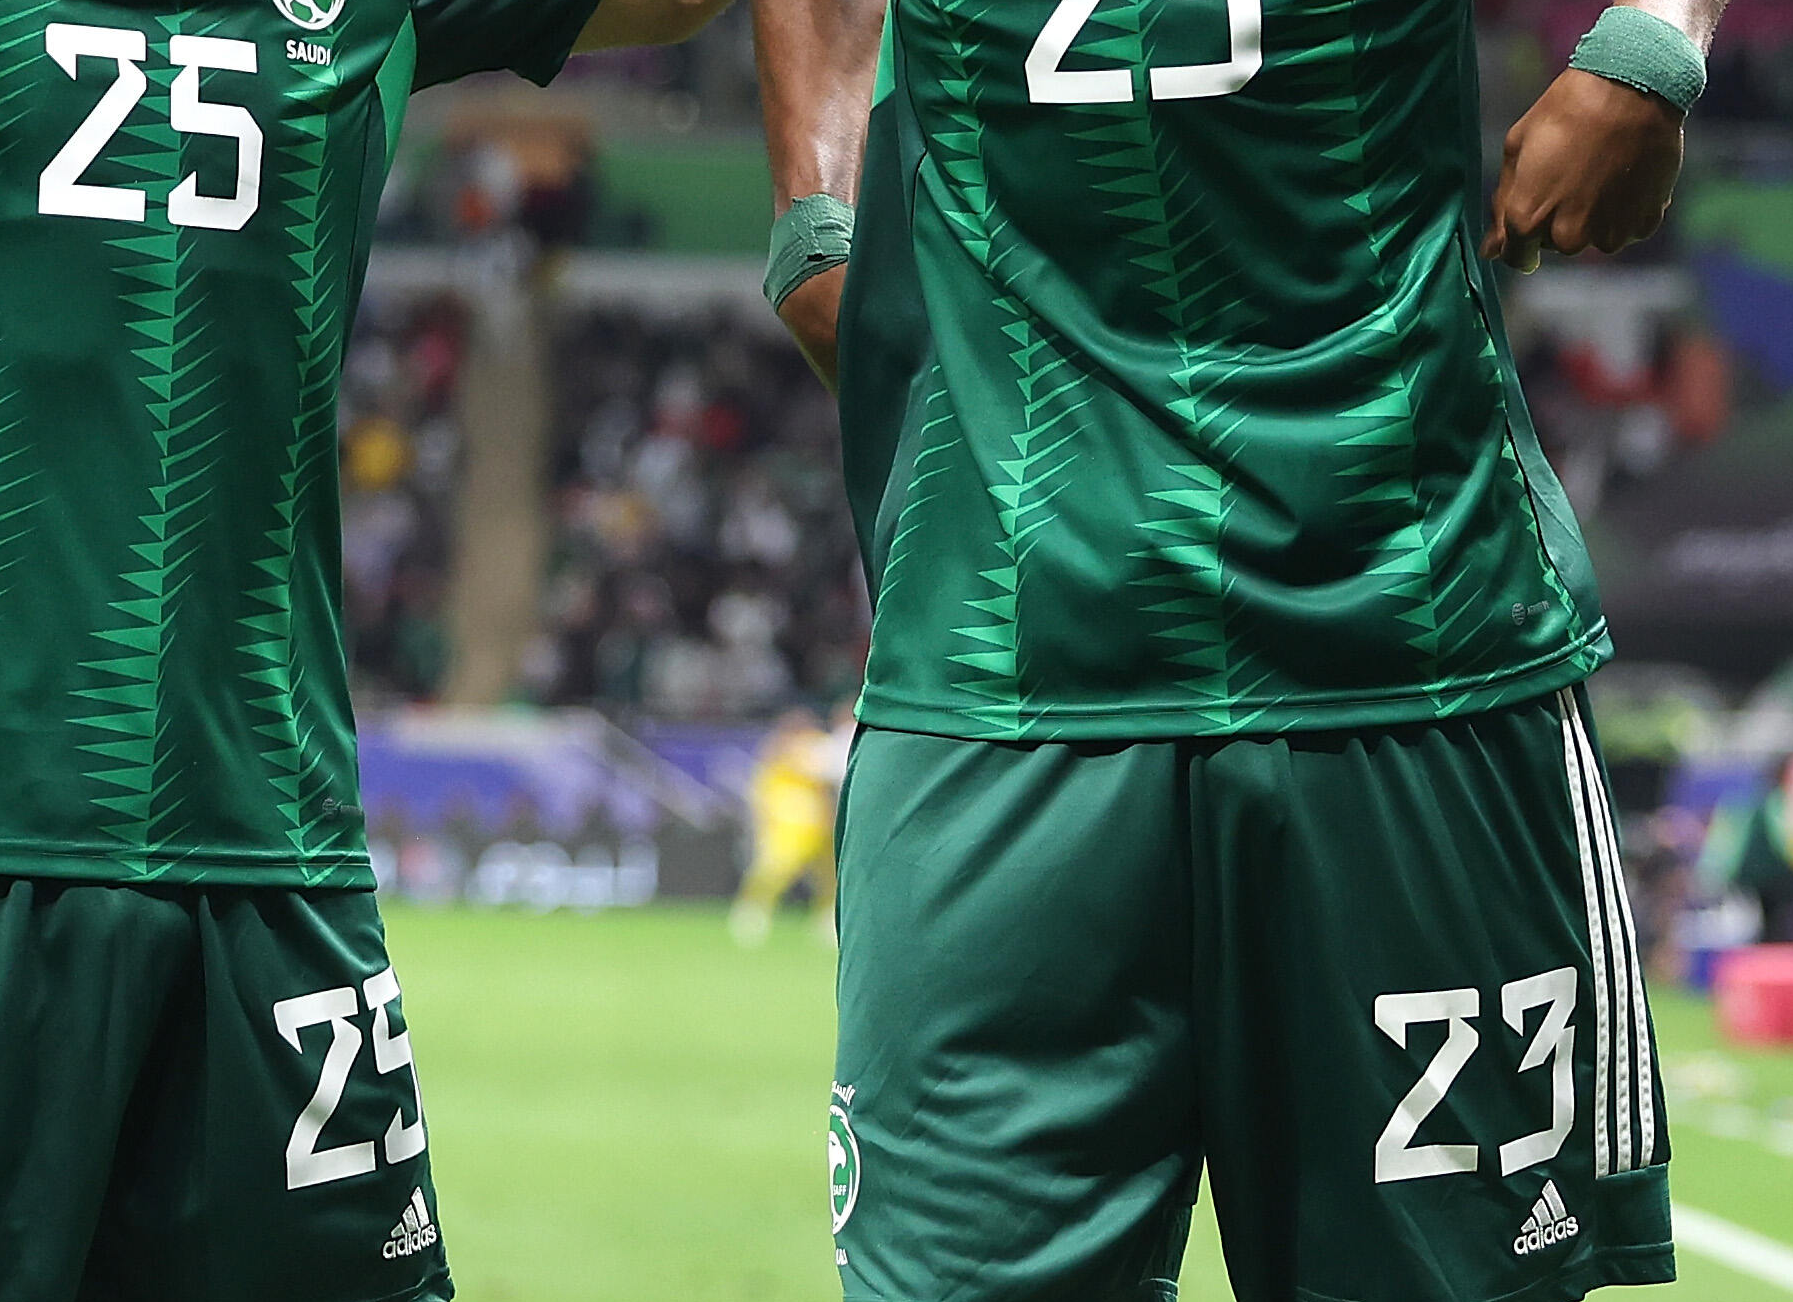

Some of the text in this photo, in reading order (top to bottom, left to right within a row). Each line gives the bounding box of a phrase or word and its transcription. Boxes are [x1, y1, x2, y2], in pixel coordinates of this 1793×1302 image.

[286, 39, 331, 66] SAUDI
[38, 23, 263, 231] 25
[273, 964, 427, 1191] 25
[1374, 966, 1578, 1184] 23
[382, 1222, 437, 1260] adidas
[1513, 1215, 1579, 1255] adidas
